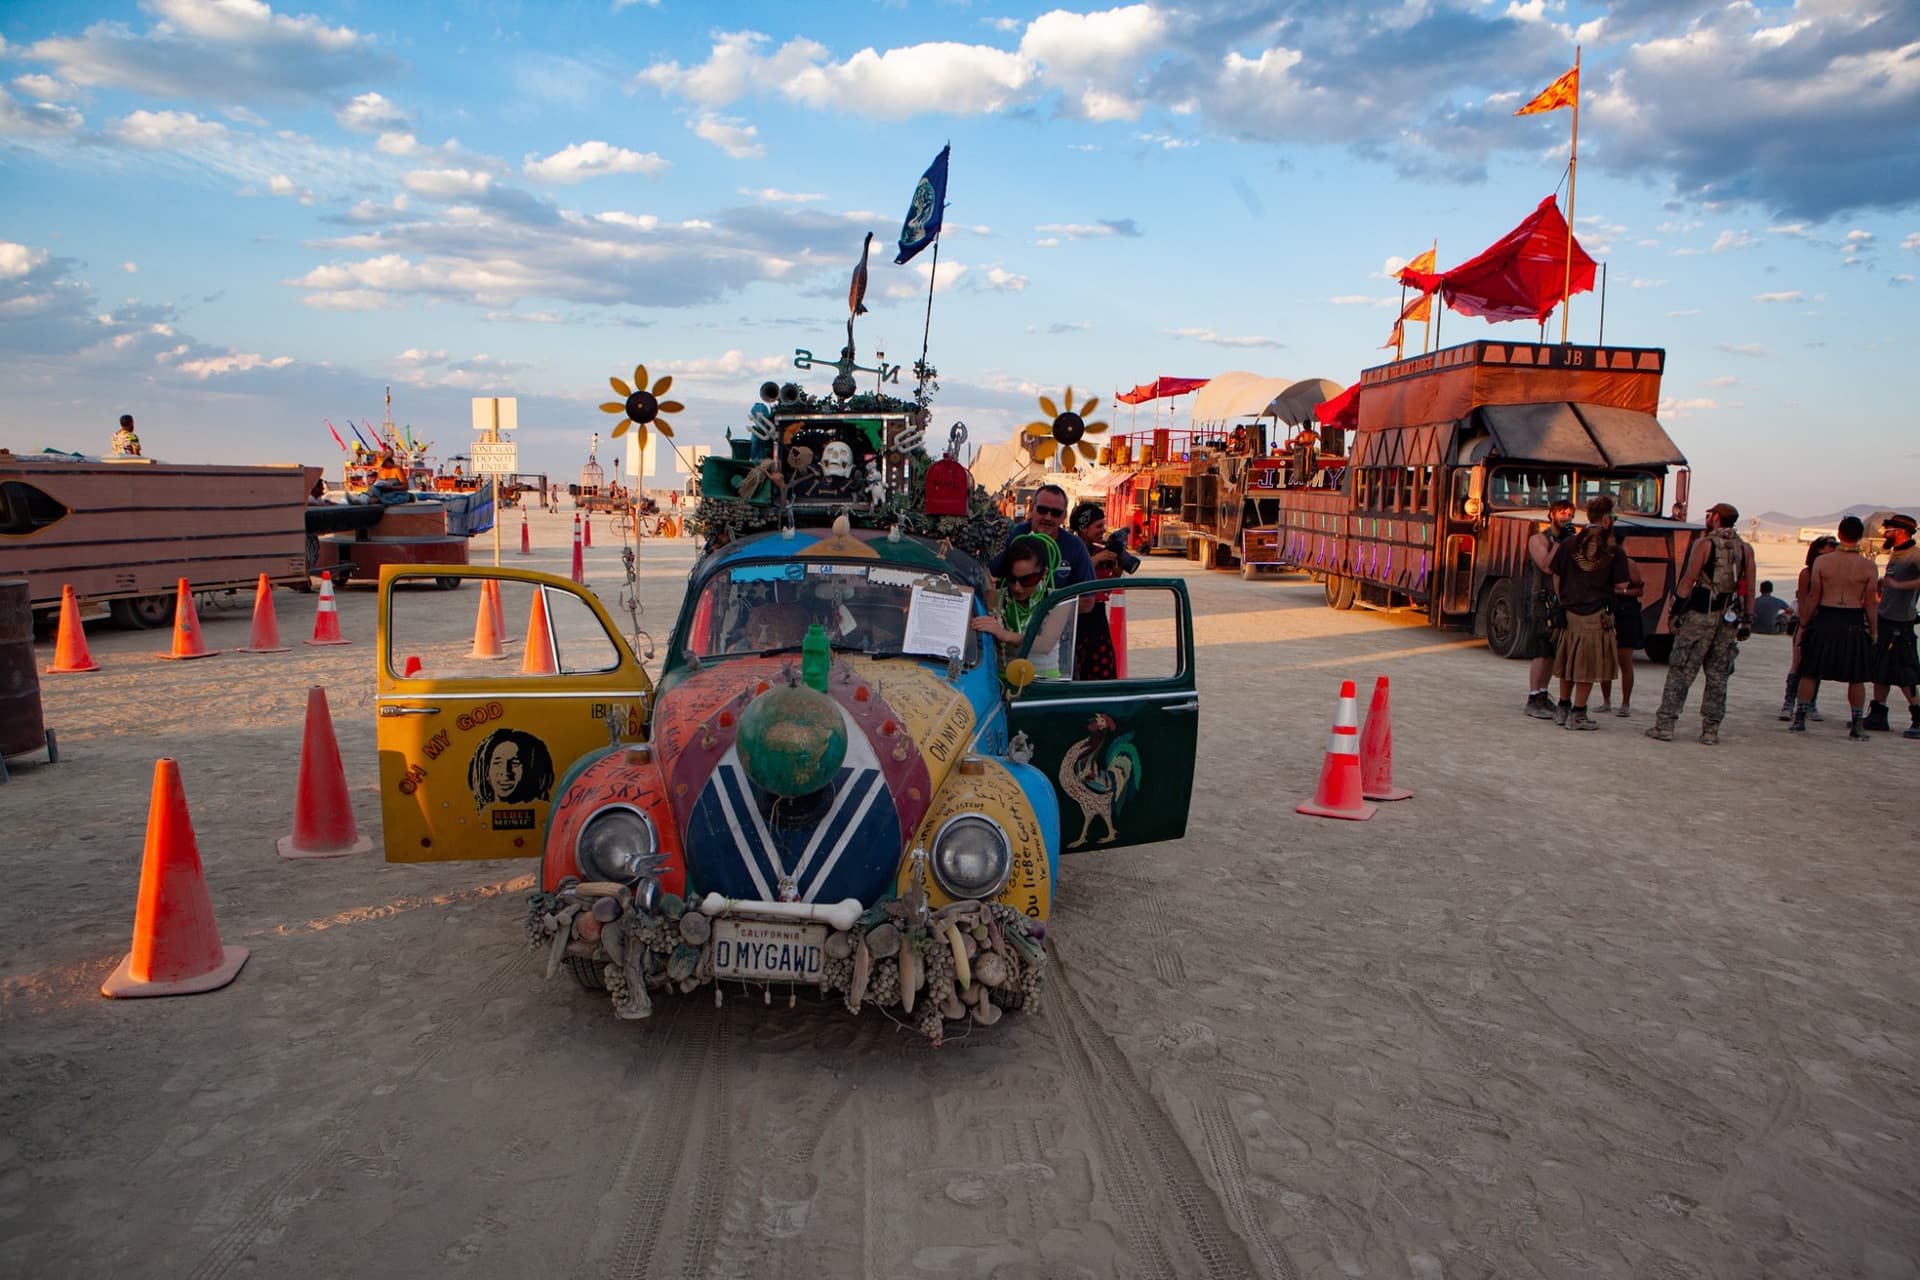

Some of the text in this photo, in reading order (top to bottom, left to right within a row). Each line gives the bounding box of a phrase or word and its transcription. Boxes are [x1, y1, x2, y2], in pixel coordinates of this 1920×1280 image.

[1564, 350, 1583, 366] JB
[477, 455, 512, 463] DO NOT
[399, 702, 503, 795] OH MY GOD
[929, 741, 950, 762] OH
[941, 724, 957, 745] MY
[1025, 895, 1040, 918] Du
[741, 928, 801, 940] CALIFORNIA
